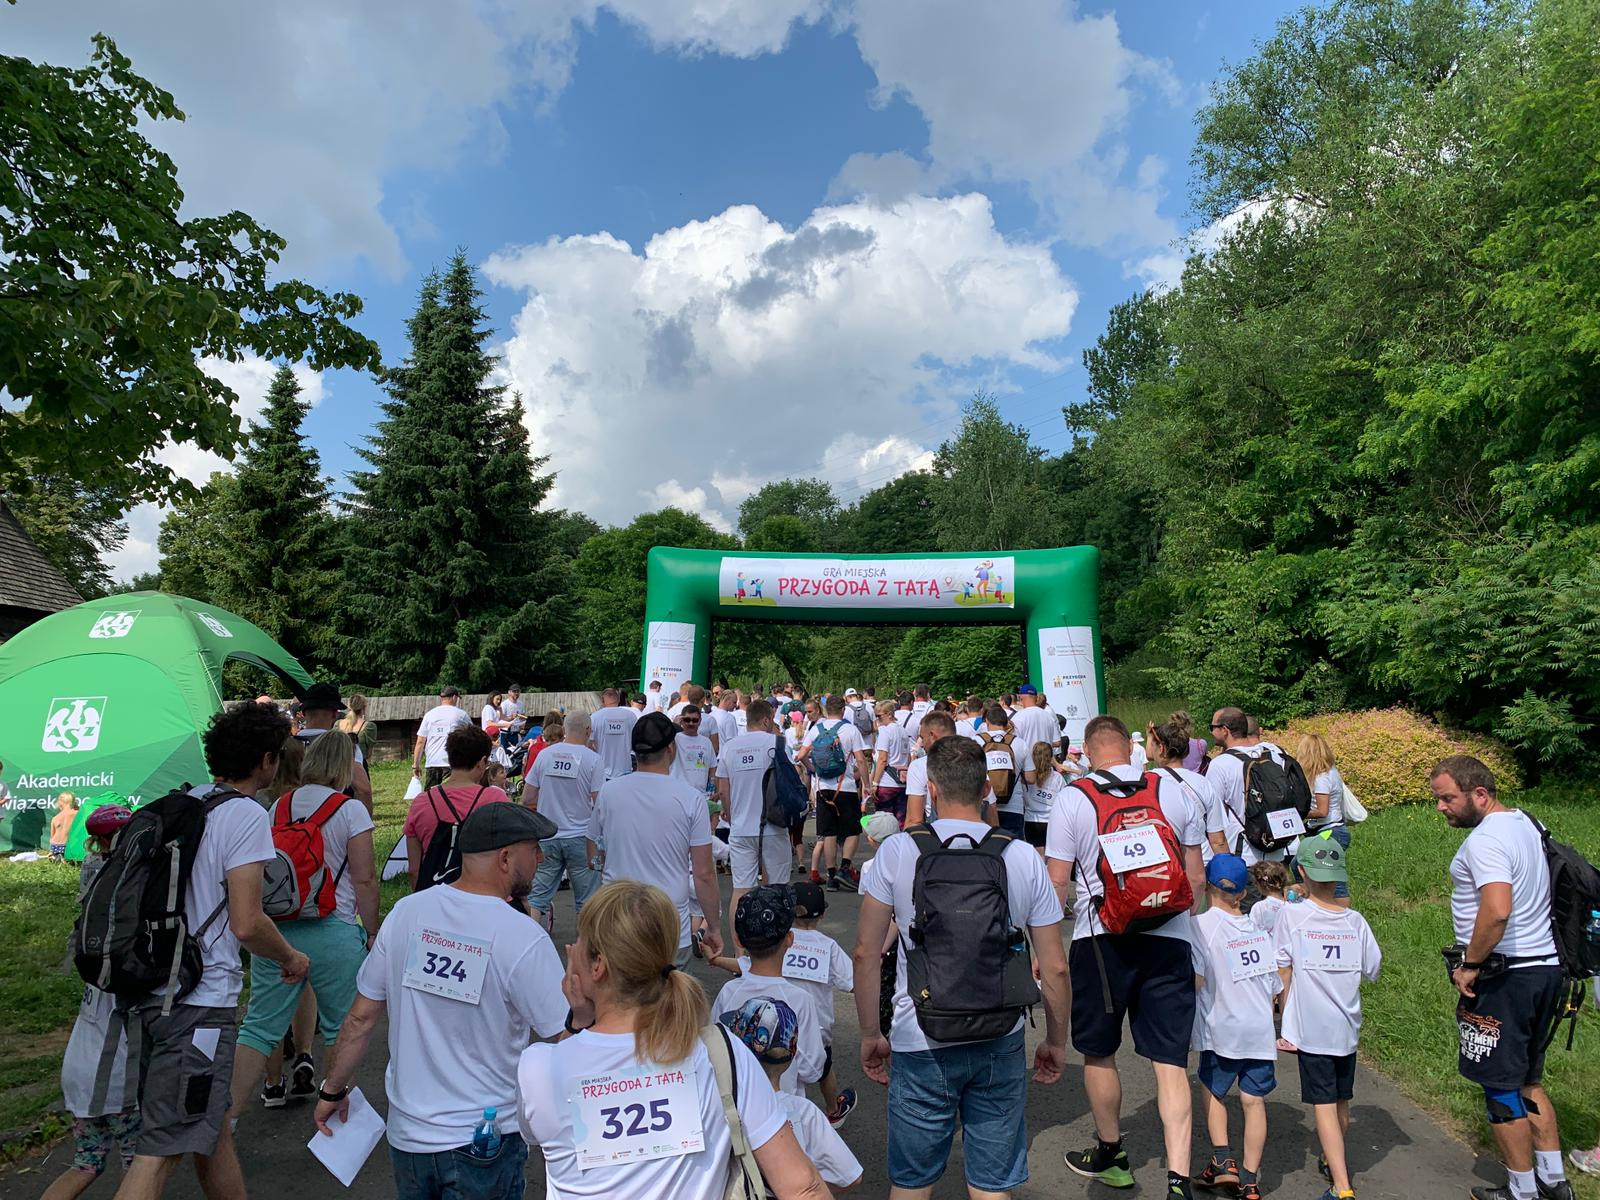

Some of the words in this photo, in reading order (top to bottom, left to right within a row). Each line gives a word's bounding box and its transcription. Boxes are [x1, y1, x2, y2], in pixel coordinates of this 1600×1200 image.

[823, 567, 842, 578] GRA
[845, 567, 887, 578] MIEJSKA
[778, 577, 871, 597] PRZYGODA
[877, 580, 888, 596] Z
[893, 579, 941, 599] TATĄ
[553, 760, 571, 771] 310
[742, 755, 754, 764] 89
[991, 757, 1008, 765] 300
[16, 771, 114, 789] Akademicki
[1282, 818, 1294, 829] 61
[1123, 842, 1147, 858] 49
[1140, 890, 1172, 908] 4F
[421, 933, 456, 949] PRZYGODA
[456, 942, 462, 950] Z
[1240, 949, 1260, 966] 50
[1322, 945, 1341, 959] 71
[422, 951, 467, 983] 324
[786, 953, 819, 970] 250
[582, 1078, 643, 1099] PRZYGODA
[644, 1076, 653, 1088] Z
[654, 1070, 685, 1085] TATĄ
[600, 1098, 673, 1140] 325
